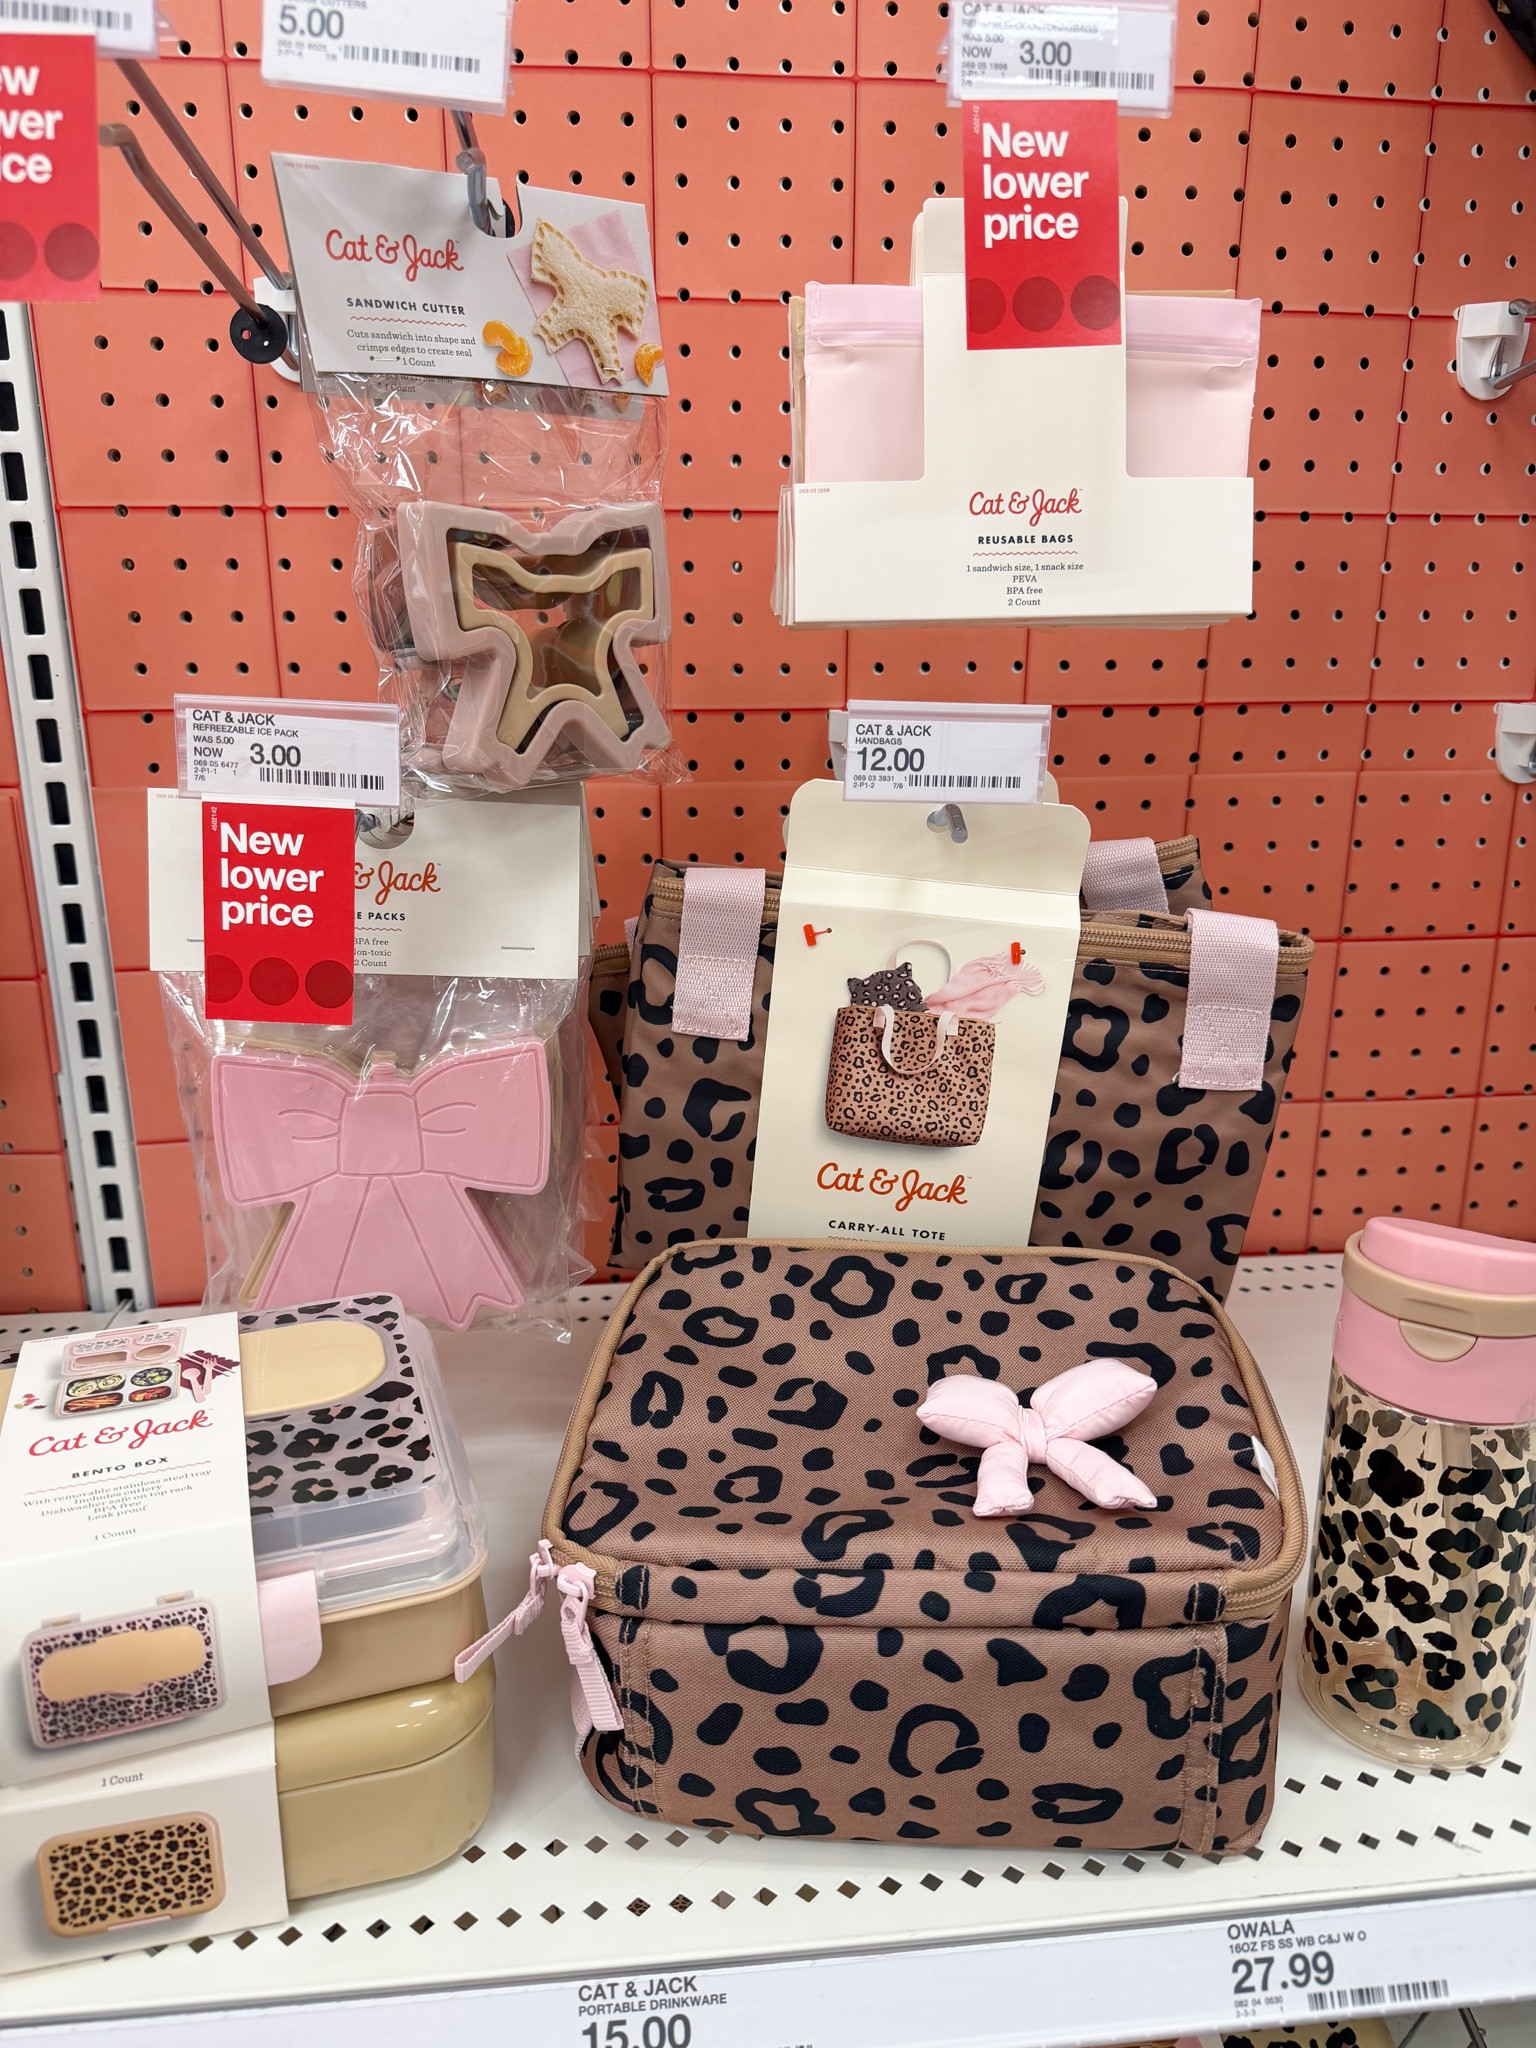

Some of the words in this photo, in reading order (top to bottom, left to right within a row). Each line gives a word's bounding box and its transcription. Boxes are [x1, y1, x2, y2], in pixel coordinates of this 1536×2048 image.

[962, 2, 992, 16] CAT
[279, 4, 344, 40] 5.00
[985, 34, 1005, 43] 5.00
[962, 46, 992, 58] NOW
[1019, 40, 1072, 66] 3.00
[982, 122, 1069, 158] New
[983, 164, 1090, 200] lower
[984, 204, 1079, 248] price
[326, 229, 372, 261] Cat
[376, 234, 400, 264] &
[403, 234, 464, 282] Jack
[346, 298, 417, 312] SANDWICH
[422, 303, 466, 315] CUTTER
[347, 330, 370, 338] Cuts
[371, 332, 413, 342] sandwich
[416, 334, 432, 342] into
[434, 334, 459, 344] shape
[460, 337, 476, 345] and
[357, 344, 389, 354] crimps
[391, 344, 415, 354] edges
[417, 346, 426, 354] to
[428, 348, 454, 356] create
[456, 349, 472, 358] seal
[409, 358, 436, 367] Count
[391, 384, 416, 392] Count
[969, 491, 1005, 516] Cat
[1008, 492, 1029, 514] &
[1030, 488, 1082, 527] Jack
[978, 535, 1036, 544] REUSABLE
[1042, 534, 1074, 544] BAGS
[972, 564, 1013, 572] sandwich
[1014, 564, 1034, 572] size,
[1041, 562, 1065, 570] snack
[1067, 562, 1084, 570] size
[1012, 575, 1037, 583] PEVA
[1026, 586, 1043, 594] free
[192, 709, 221, 722] CAT
[224, 713, 234, 724] &
[238, 712, 276, 726] JACK
[193, 724, 255, 734] REFREEZABLE
[258, 728, 272, 736] ICE
[274, 729, 298, 738] PACK
[193, 736, 213, 744] WAS
[216, 736, 234, 744] 5.00
[856, 724, 882, 736] CAT
[885, 725, 894, 736] &
[897, 725, 932, 736] JACK
[856, 737, 902, 745] HANDBAGS
[194, 747, 223, 758] NOW
[250, 743, 301, 767] 3.00
[858, 747, 925, 772] 12.00
[893, 782, 903, 790] 7/6
[220, 822, 304, 856] New
[221, 858, 324, 892] lower
[375, 860, 441, 905] Jack
[222, 895, 314, 930] price
[368, 912, 406, 920] PACKS
[361, 959, 387, 967] Count
[817, 1162, 864, 1192] Cat
[869, 1168, 899, 1195] &
[895, 1170, 968, 1212] Jack
[828, 1220, 905, 1236] CARRY-ALL
[912, 1229, 946, 1241] TOTE
[29, 1432, 88, 1456] Cat
[94, 1426, 129, 1444] &
[128, 1410, 214, 1449] Jack
[72, 1464, 126, 1478] BENTO
[134, 1457, 169, 1468] BOX
[24, 1498, 50, 1507] With
[54, 1488, 111, 1502] removable
[163, 1474, 188, 1482] steel
[191, 1470, 212, 1478] tray
[41, 1501, 106, 1517] Dishwasher
[150, 1490, 167, 1498] top
[170, 1485, 192, 1494] rack
[117, 1505, 148, 1517] proof
[102, 1528, 136, 1539] Count
[101, 1778, 106, 1787] 1
[109, 1772, 143, 1785] Count
[1227, 1919, 1295, 1940] OWALA
[1229, 1942, 1258, 1954] 16OZ
[1261, 1940, 1275, 1950] FS
[1278, 1938, 1293, 1949] SS
[1296, 1936, 1315, 1947] WB
[1318, 1934, 1340, 1945] C&J
[1343, 1932, 1354, 1942] W
[1232, 1950, 1334, 1994] 27.99
[578, 1983, 619, 2002] CAT
[624, 1981, 638, 1998] &
[644, 1975, 698, 1996] JACK
[578, 2000, 646, 2016] PORTABLE
[650, 1993, 727, 2011] DRINKWARE
[582, 2013, 692, 2048] 15.00
